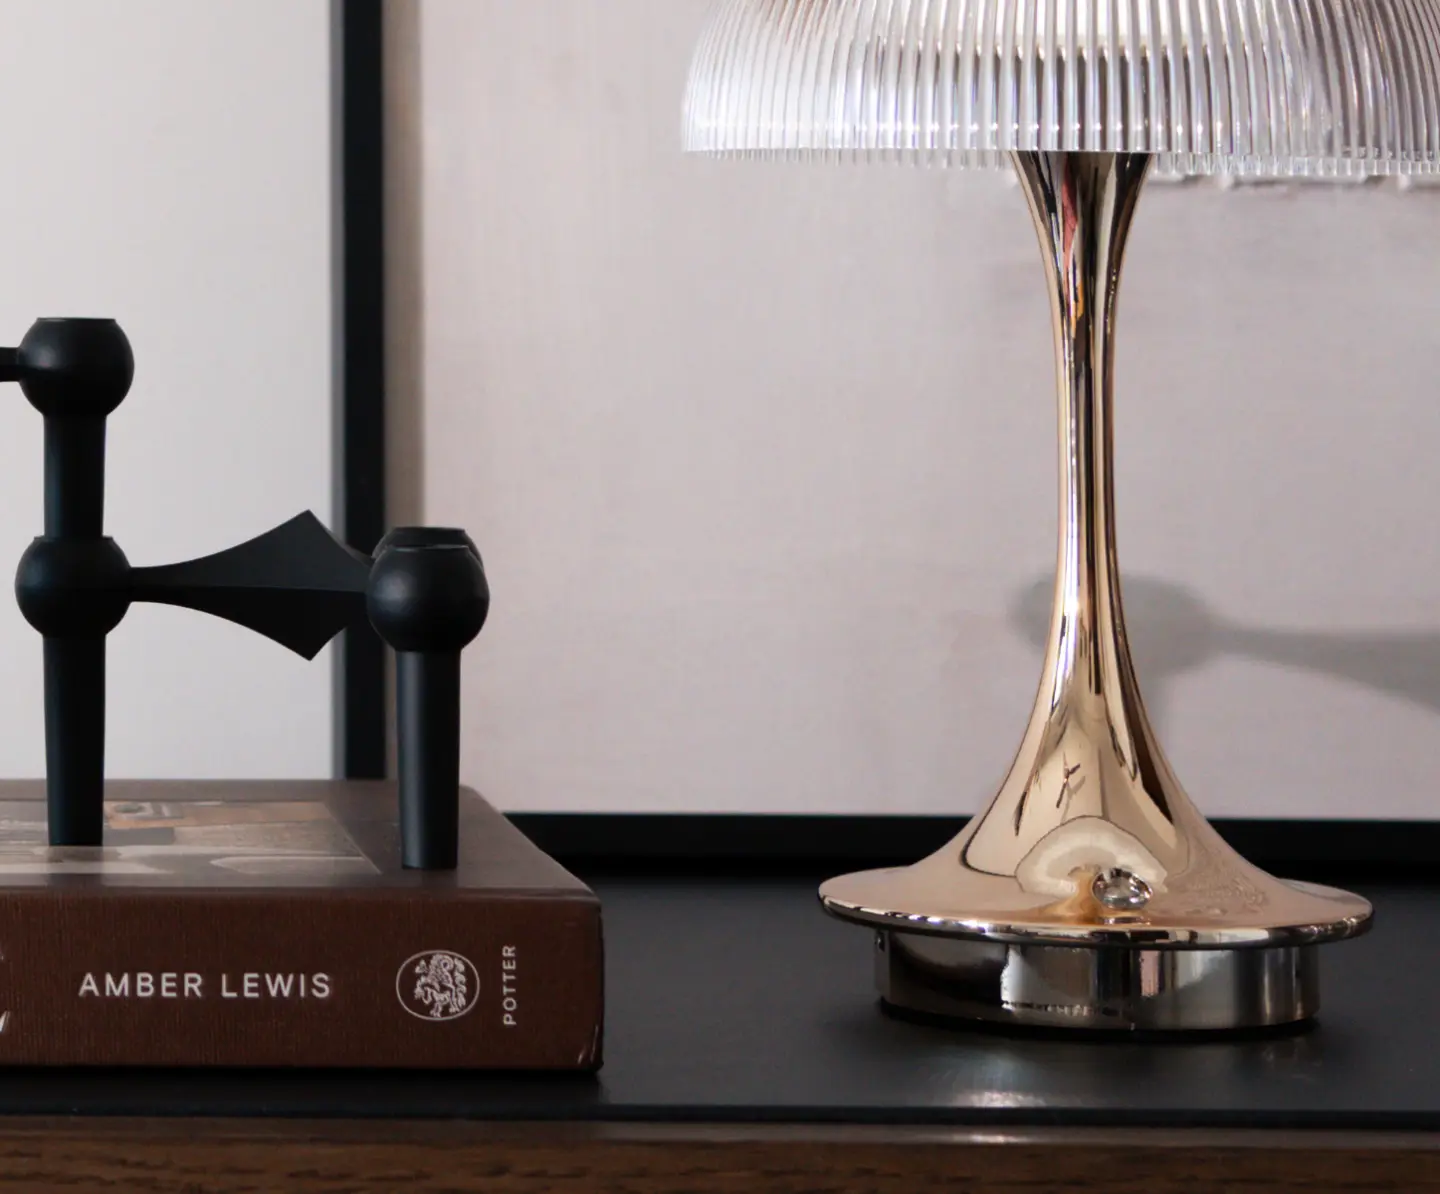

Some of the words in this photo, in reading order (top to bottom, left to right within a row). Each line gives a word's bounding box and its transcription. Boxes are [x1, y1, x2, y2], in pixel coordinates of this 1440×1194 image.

[78, 972, 203, 998] AMBER
[221, 972, 332, 998] LEWIS
[502, 945, 517, 1025] POTTER
